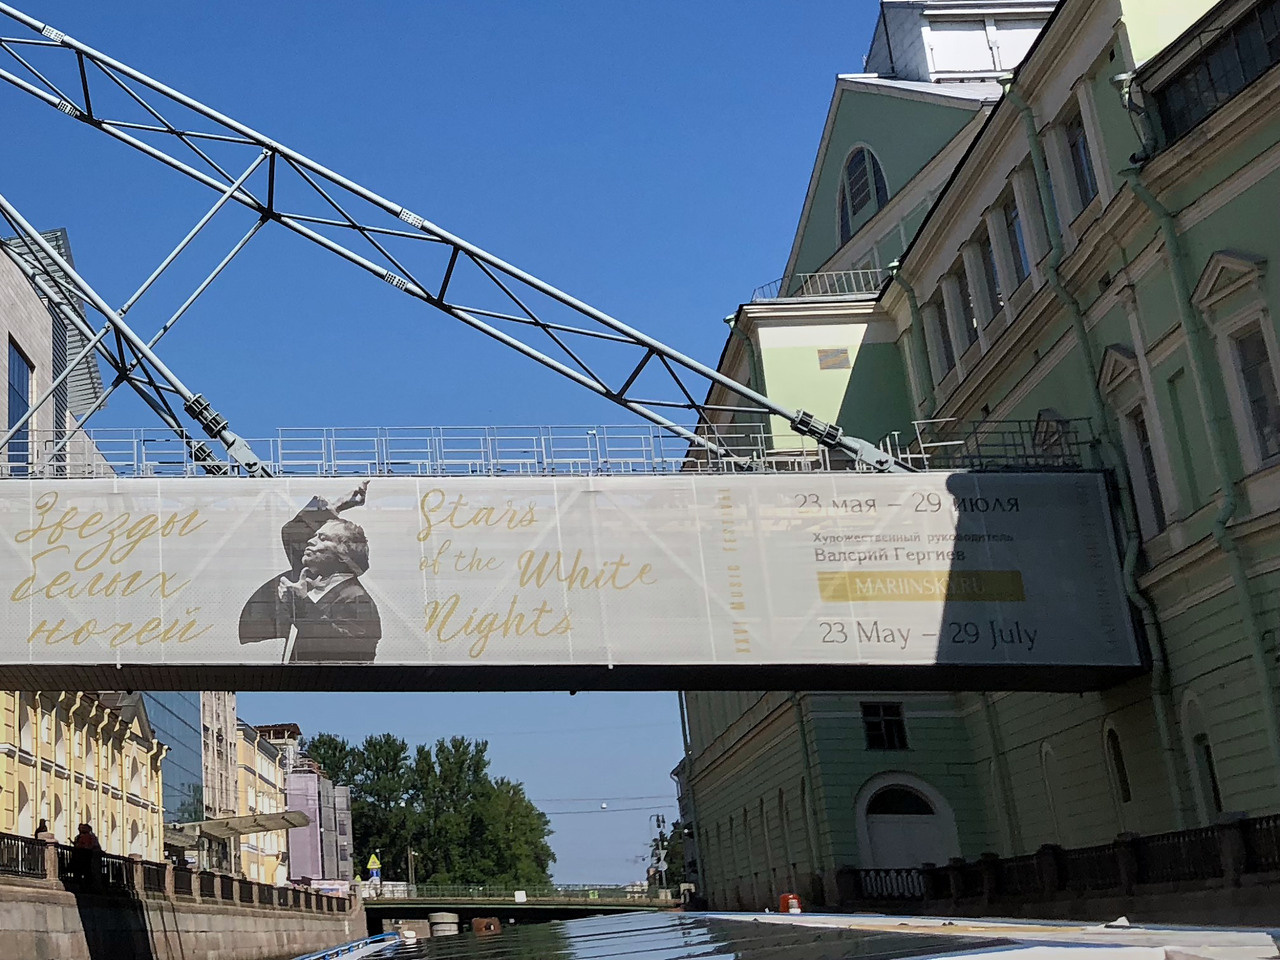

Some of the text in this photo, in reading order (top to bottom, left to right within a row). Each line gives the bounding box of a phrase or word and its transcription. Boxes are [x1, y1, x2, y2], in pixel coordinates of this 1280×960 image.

[417, 488, 538, 542] Stars
[795, 493, 822, 511] 23
[832, 497, 877, 513] мая
[912, 492, 942, 513] 29
[953, 496, 1020, 513] июля
[15, 491, 208, 571] Звезды
[813, 531, 921, 545] Художественный
[10, 545, 192, 602] белых
[419, 539, 658, 591] of the White
[815, 547, 966, 566] Валерий Гергиев
[26, 606, 215, 650] ночей
[423, 594, 574, 658] Nights
[819, 621, 848, 644] 23
[857, 621, 912, 650] May
[949, 622, 980, 644] 29
[989, 619, 1039, 651] July
